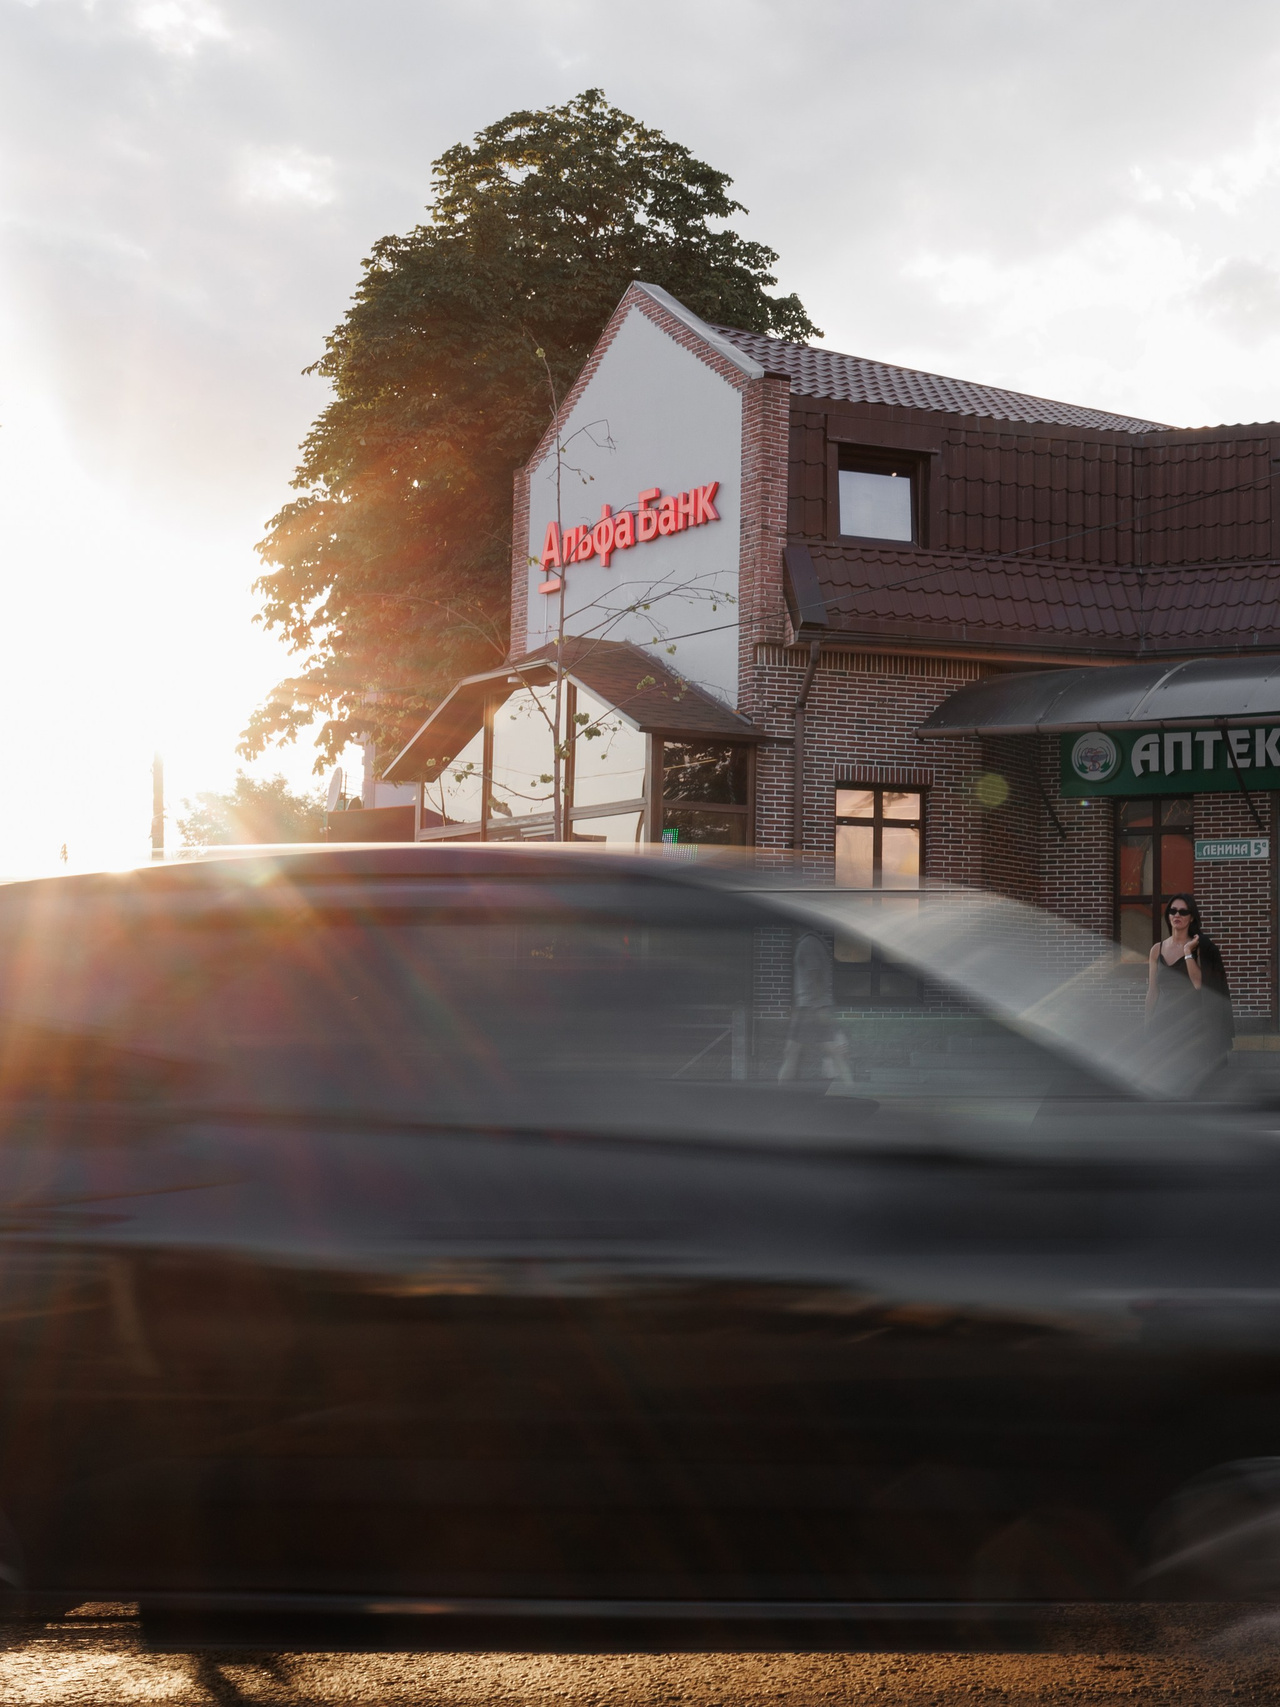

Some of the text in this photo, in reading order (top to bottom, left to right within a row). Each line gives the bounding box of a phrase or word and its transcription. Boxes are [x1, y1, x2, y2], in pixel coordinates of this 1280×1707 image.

[539, 481, 721, 571] Альфа Банк
[1202, 843, 1248, 856] ЛЕНИНА
